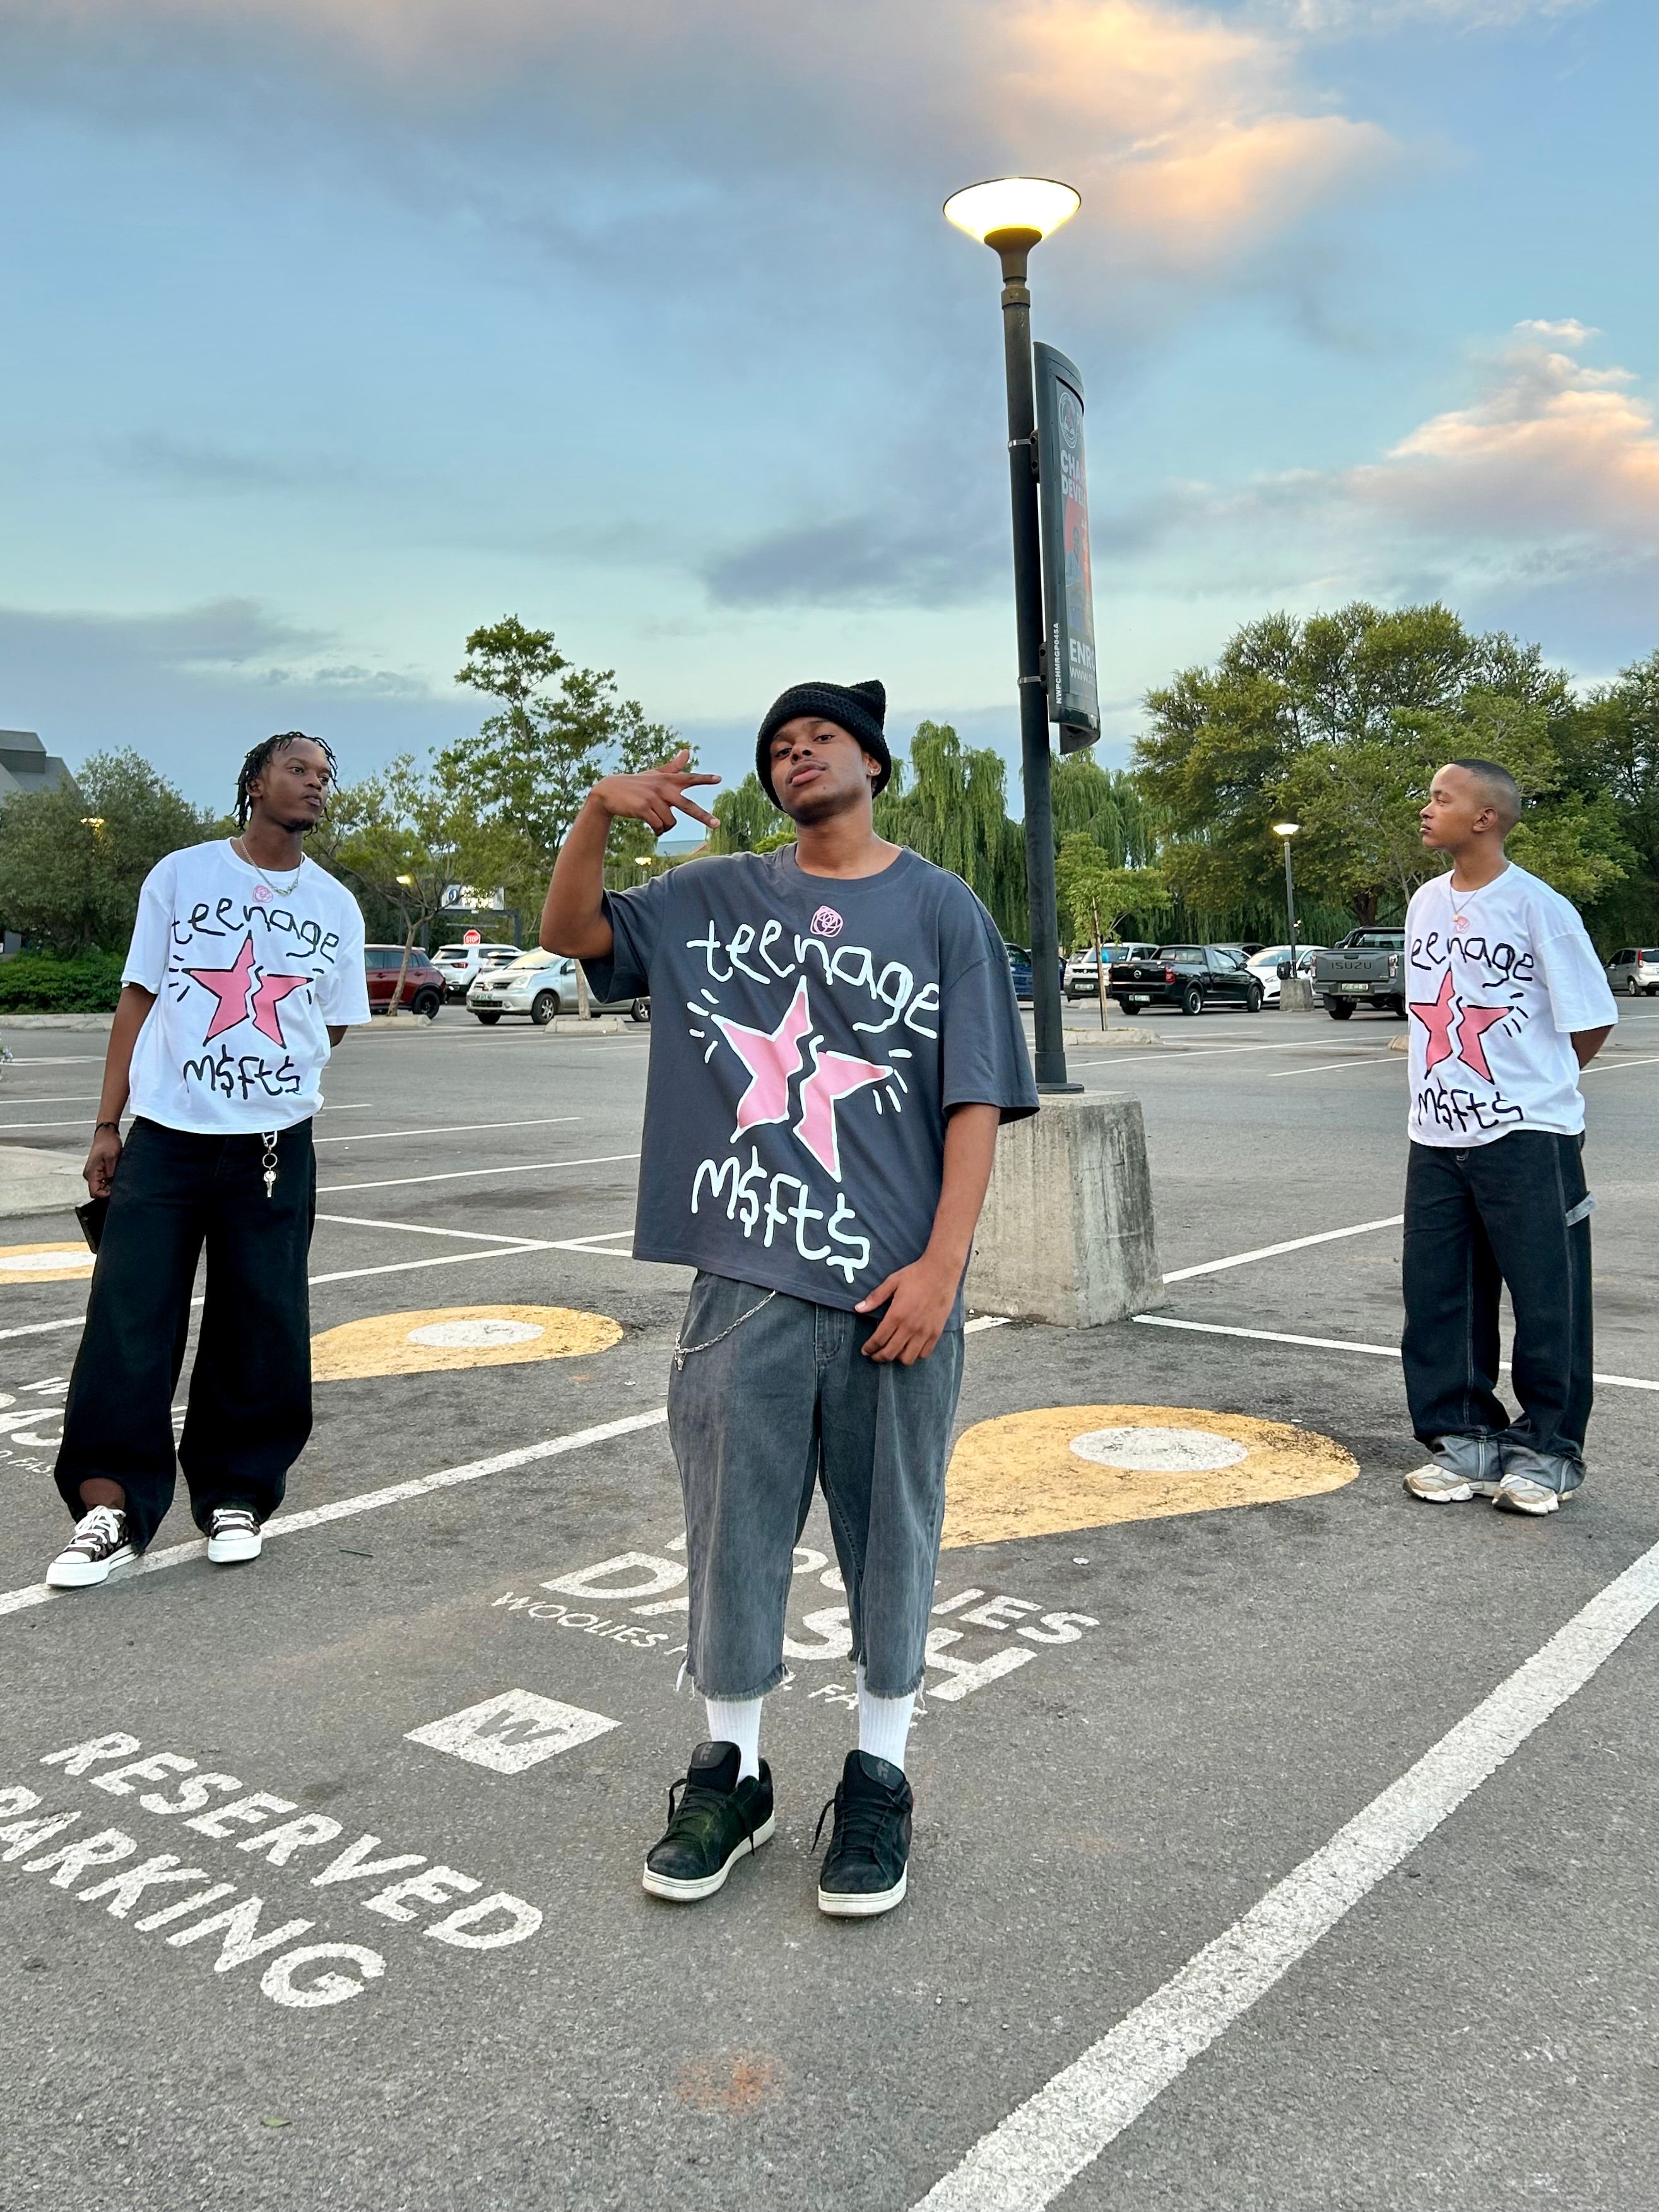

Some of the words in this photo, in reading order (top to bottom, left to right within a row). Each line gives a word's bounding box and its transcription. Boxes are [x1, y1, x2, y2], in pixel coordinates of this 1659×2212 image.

[171, 898, 339, 964] teenage
[1331, 962, 1372, 970] ISUZU
[1410, 932, 1534, 989] eenage
[686, 919, 940, 1039] teenage
[491, 1592, 669, 1647] WOOLIES
[538, 1551, 1038, 1702] DSH
[40, 1731, 544, 1950] RESERVED
[0, 1785, 386, 2008] PARKING
